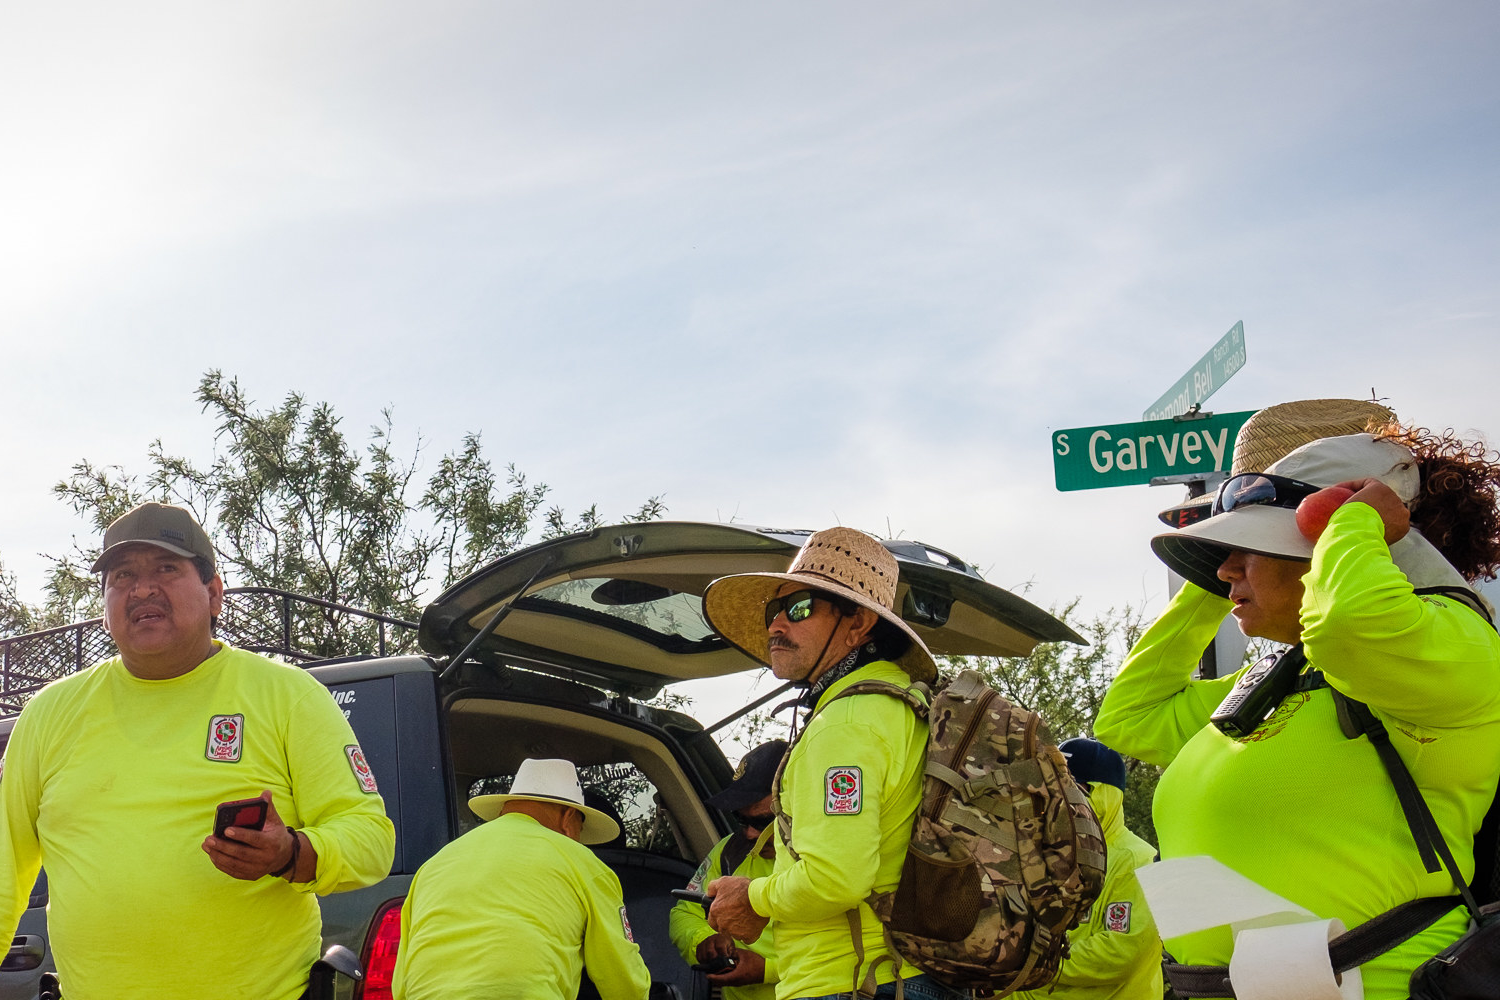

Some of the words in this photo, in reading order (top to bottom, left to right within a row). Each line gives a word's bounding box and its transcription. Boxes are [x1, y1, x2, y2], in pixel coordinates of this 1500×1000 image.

[1150, 382, 1190, 421] mond
[1194, 360, 1213, 402] Bell
[1056, 433, 1070, 456] S
[1088, 428, 1228, 474] Garvey
